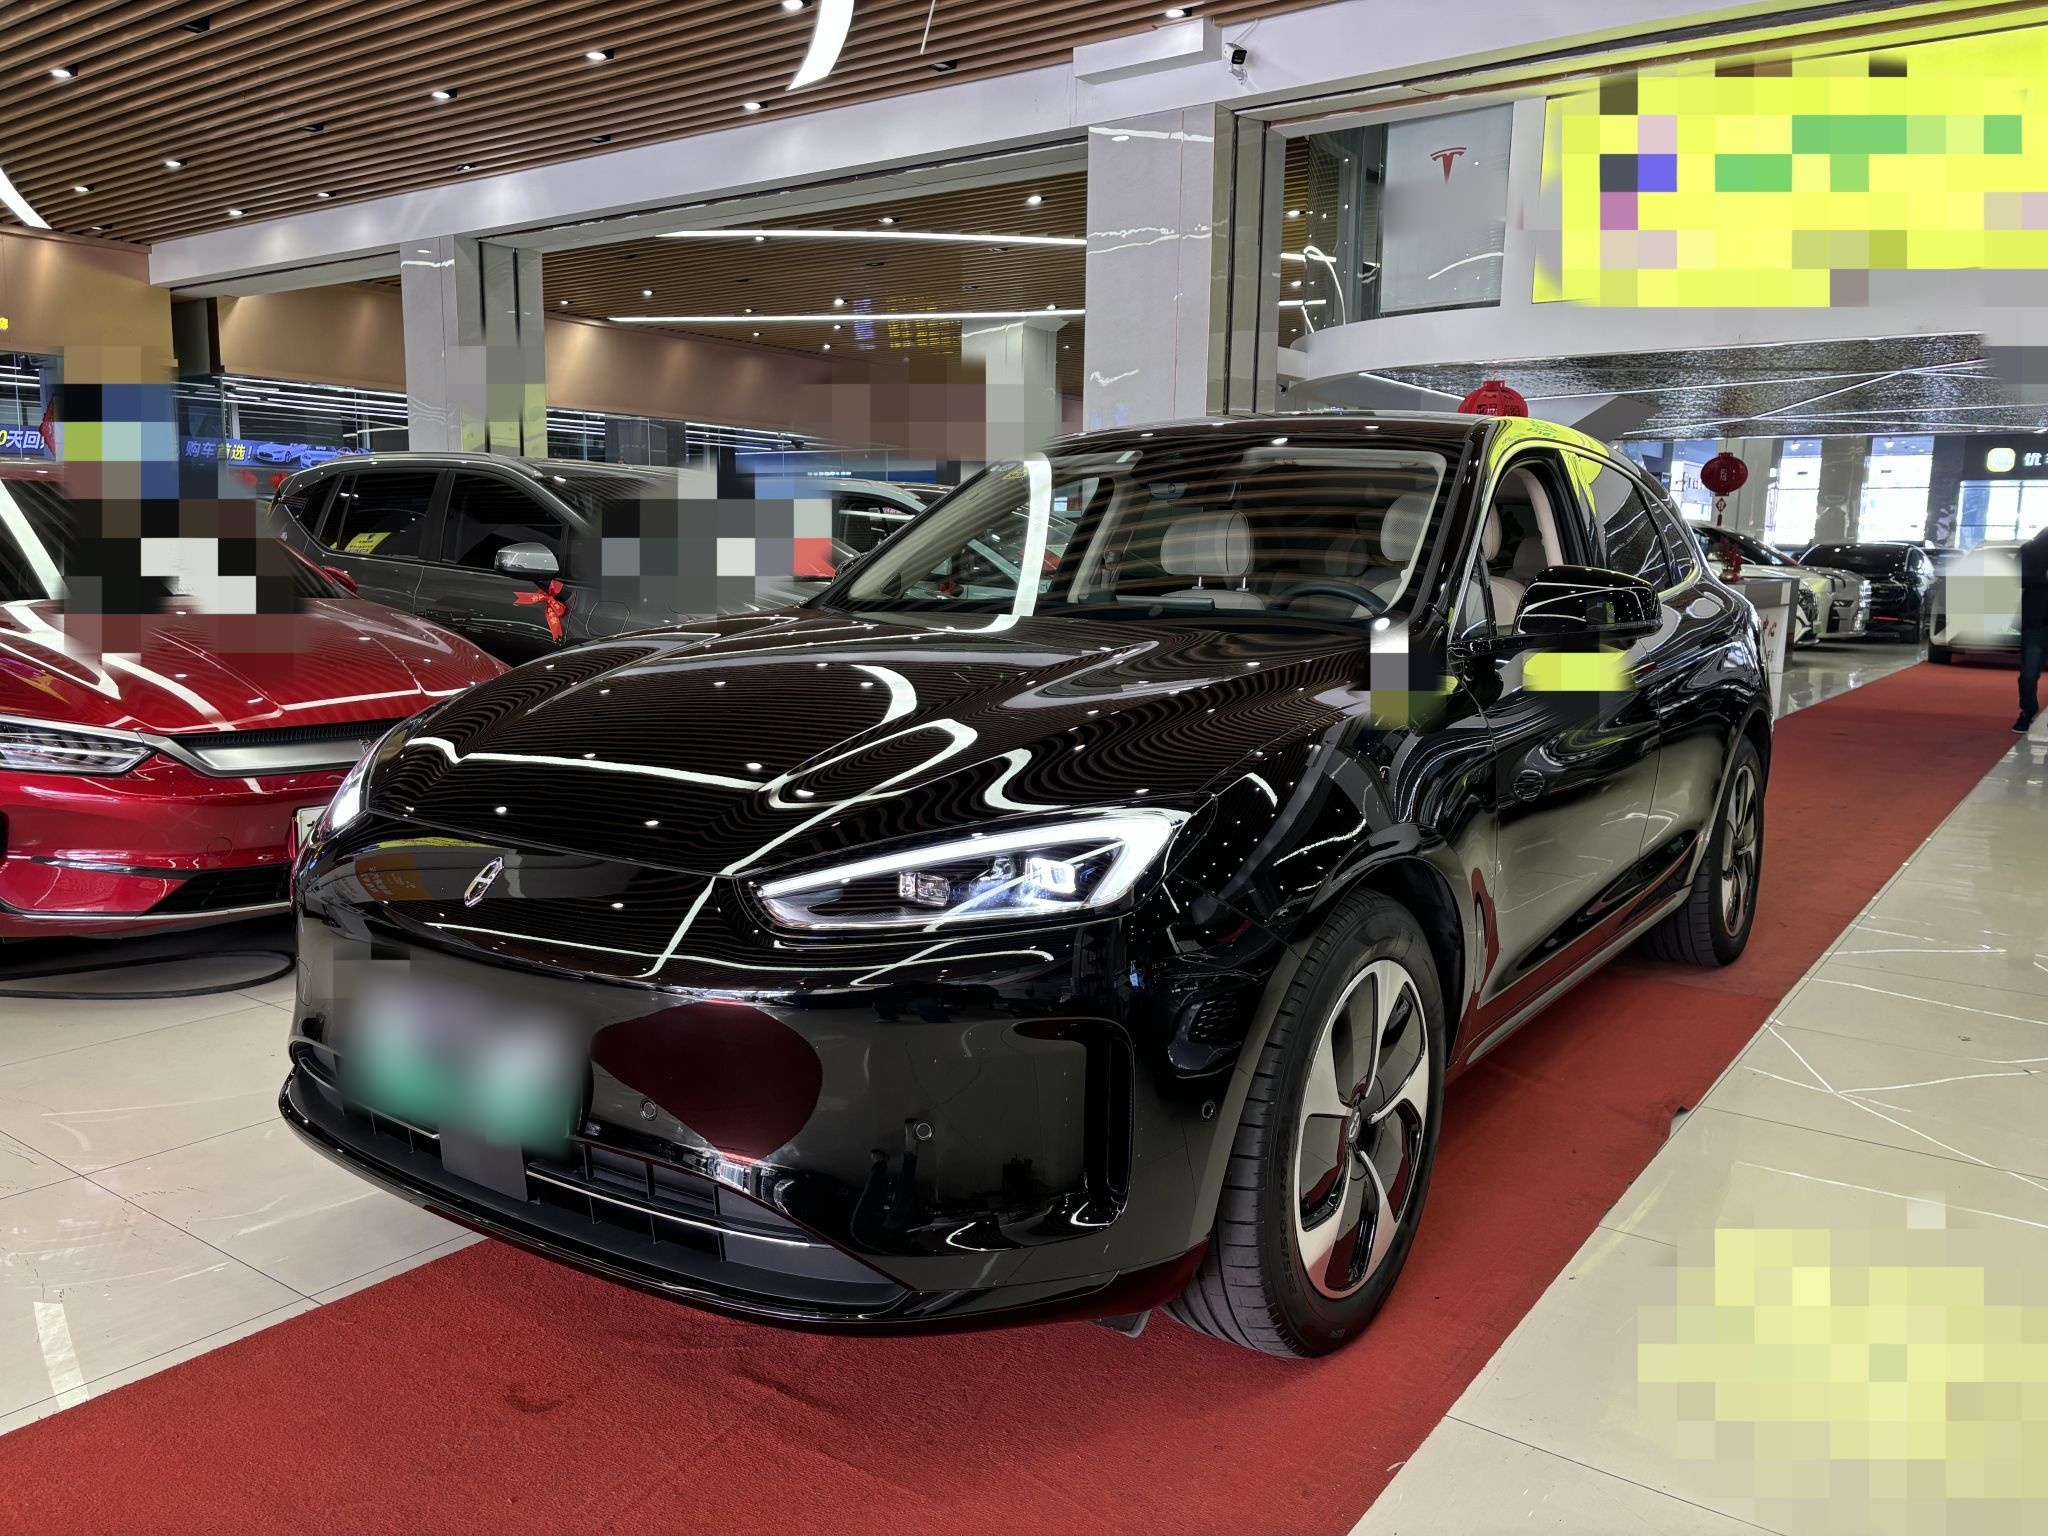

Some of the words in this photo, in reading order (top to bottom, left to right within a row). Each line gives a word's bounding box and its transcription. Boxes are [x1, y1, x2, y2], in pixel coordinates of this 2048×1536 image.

[0, 430, 45, 449] 0天回
[185, 440, 253, 461] 购车首选!
[2024, 452, 2048, 467] 优
[1279, 1220, 1298, 1296] 255/50
